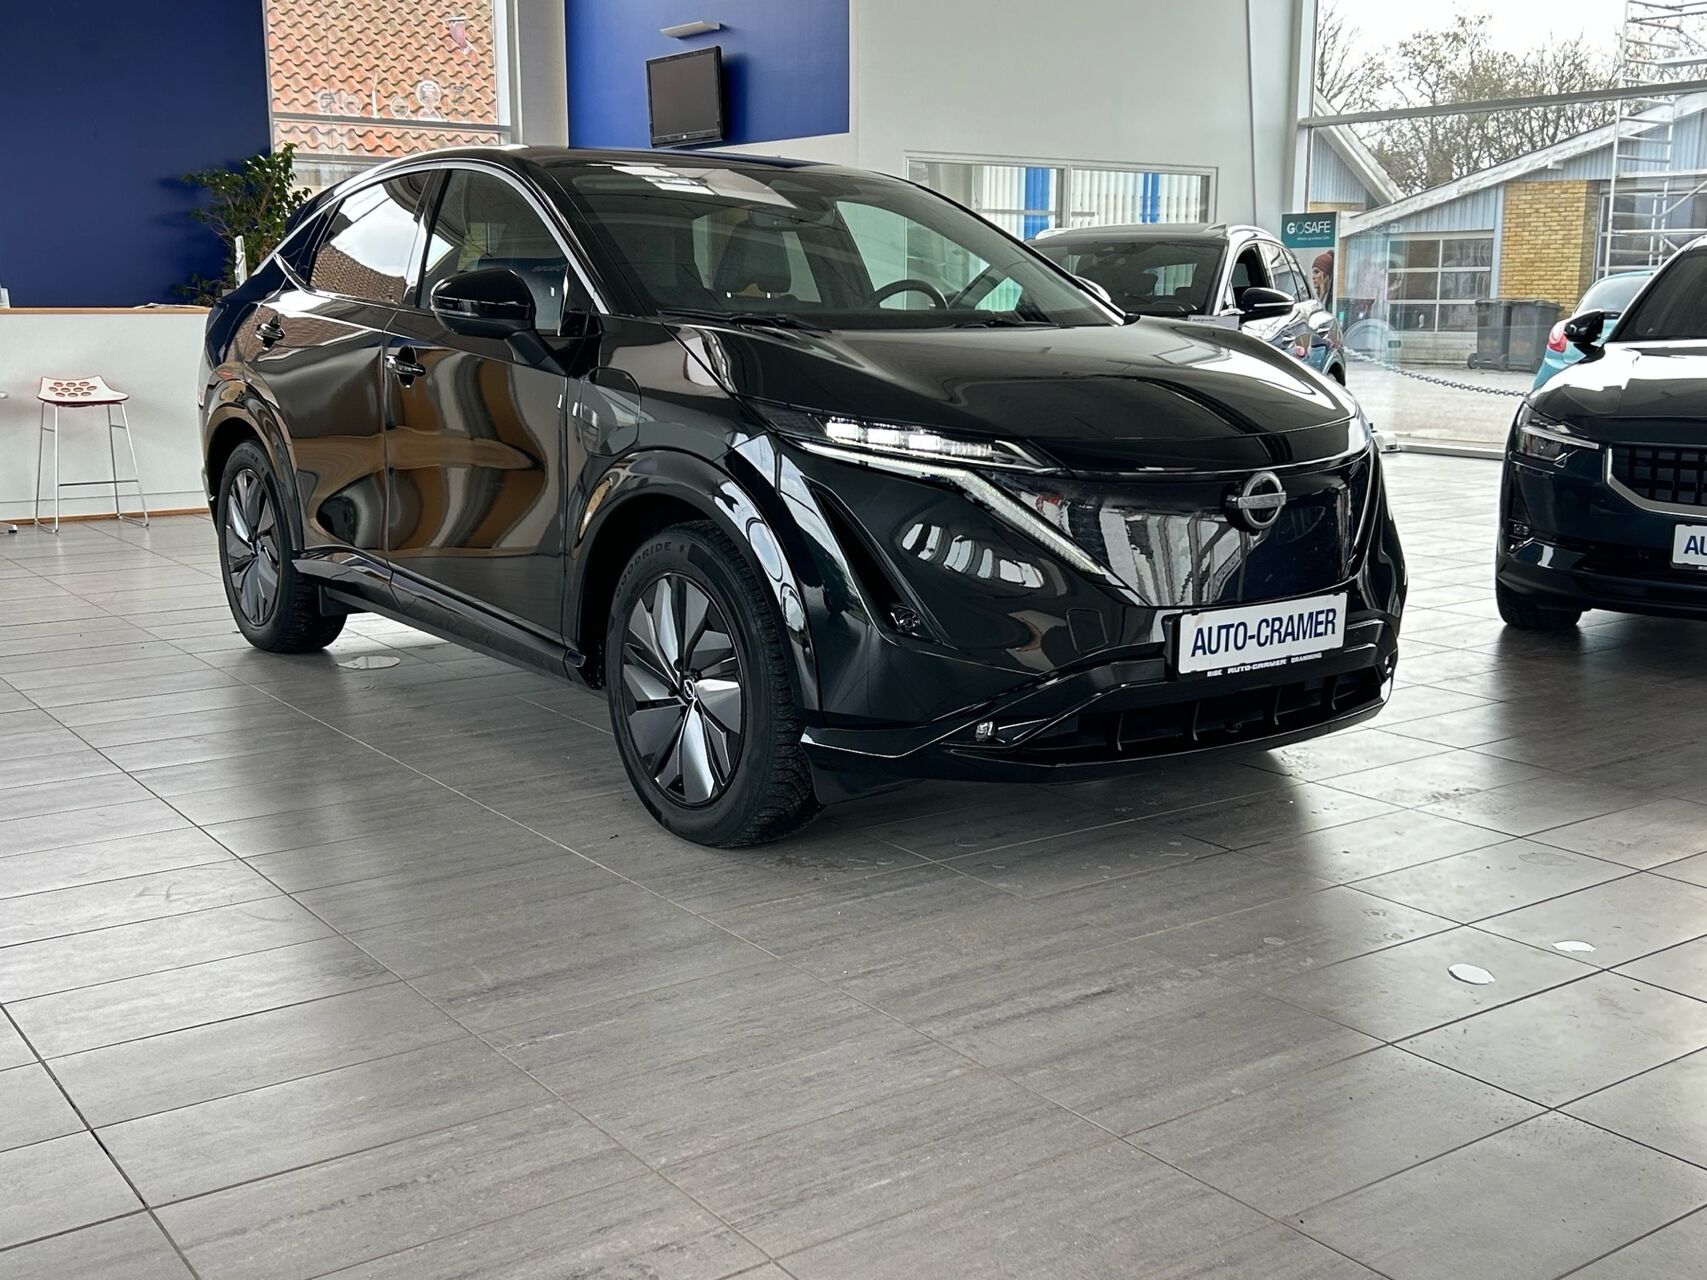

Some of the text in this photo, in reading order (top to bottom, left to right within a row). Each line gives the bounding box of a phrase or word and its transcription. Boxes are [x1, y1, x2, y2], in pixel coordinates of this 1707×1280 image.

[1287, 221, 1331, 234] GOSAFE
[1190, 608, 1337, 658] AUTO-CRAMER
[1227, 659, 1287, 674] AUTO-CRAMER
